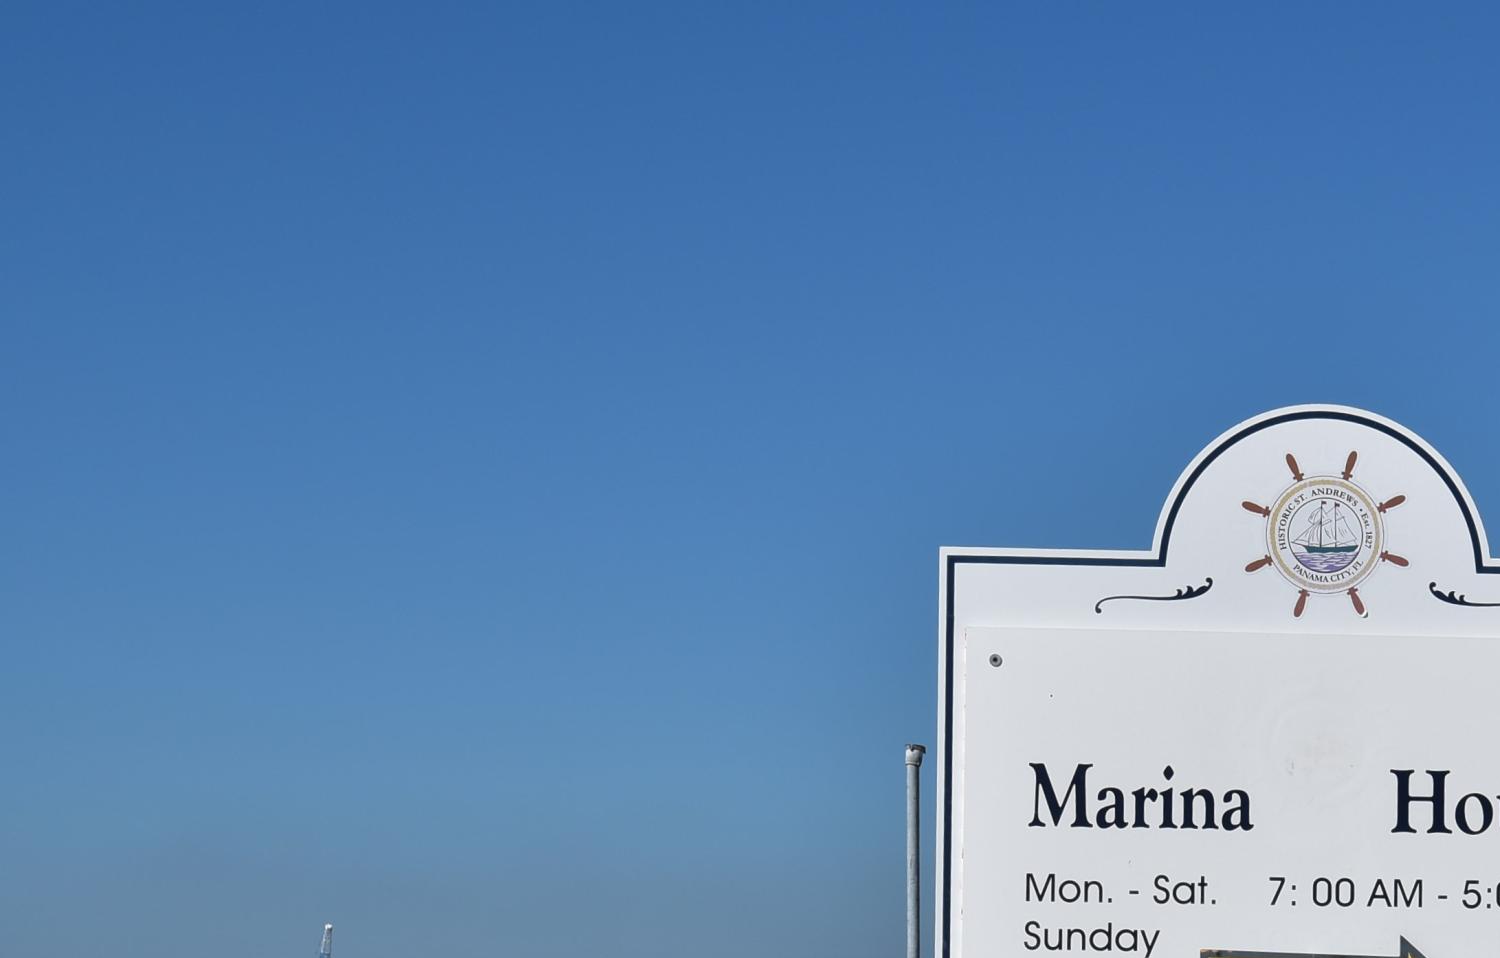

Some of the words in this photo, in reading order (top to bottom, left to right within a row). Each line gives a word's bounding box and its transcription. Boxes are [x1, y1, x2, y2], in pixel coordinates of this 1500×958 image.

[1278, 503, 1296, 550] HISTORIC
[1294, 493, 1308, 505] ST.
[1311, 488, 1358, 507] ANDREWS
[1293, 564, 1329, 583] PANAMA
[1352, 560, 1364, 573] FL
[1029, 763, 1255, 832] Marina
[1026, 874, 1112, 902] Mon.
[1154, 875, 1216, 904] Sat.
[1367, 879, 1424, 908] AM
[1023, 921, 1160, 958] Sunday
